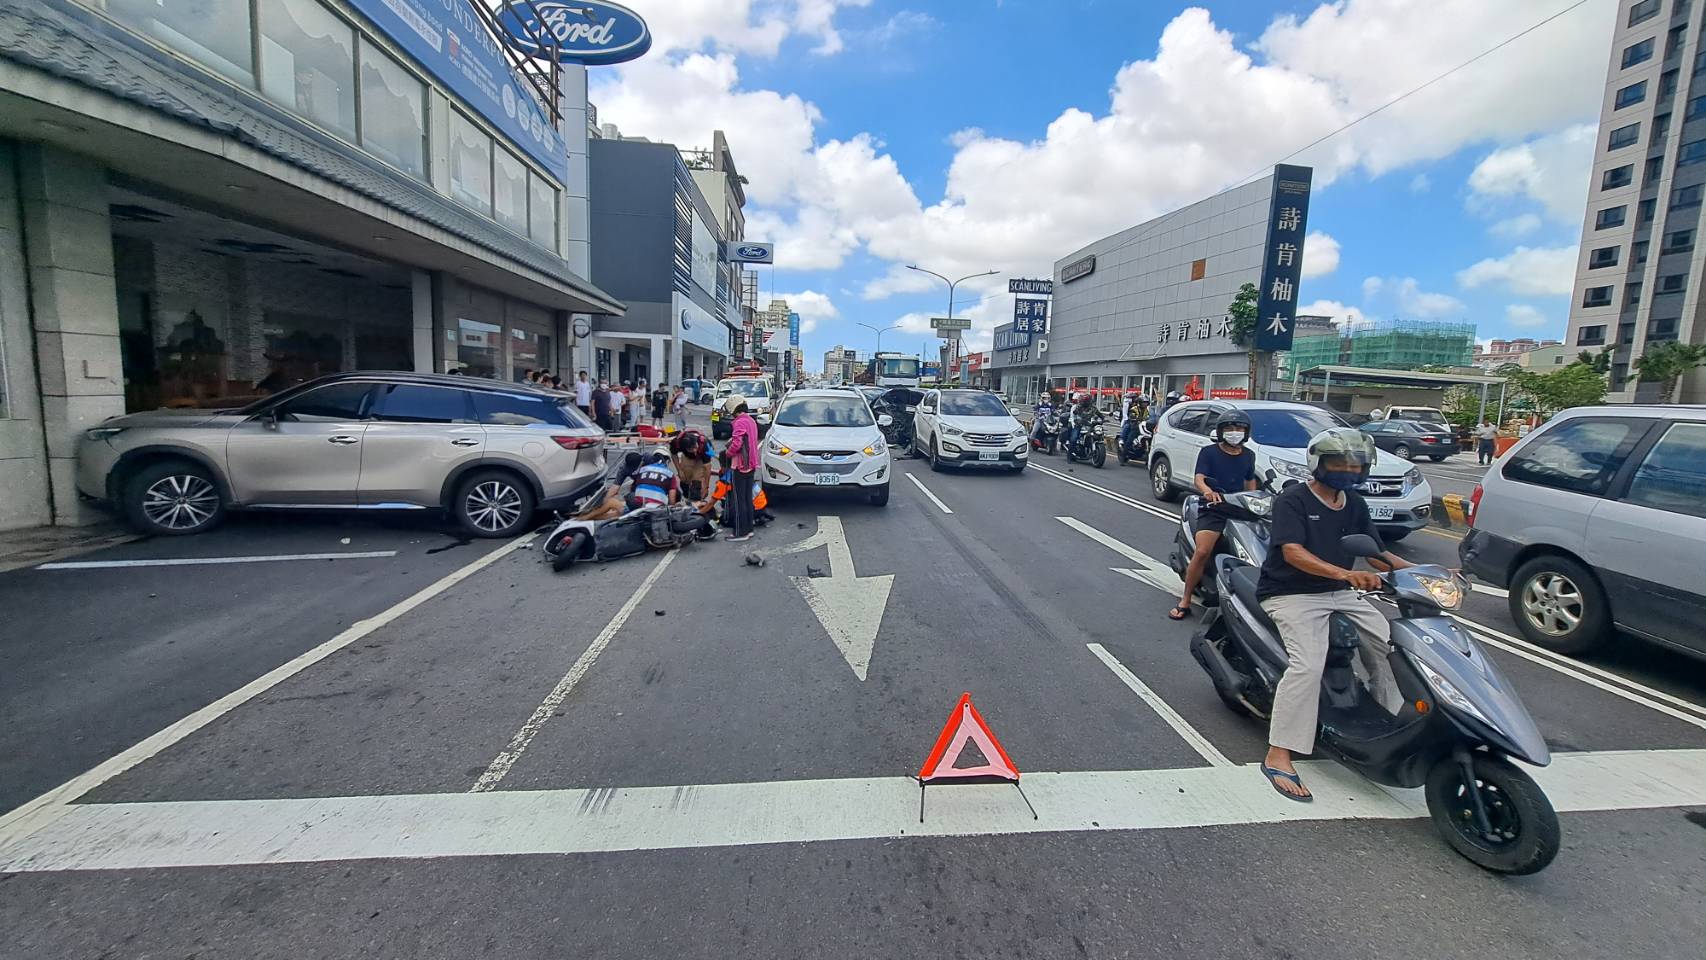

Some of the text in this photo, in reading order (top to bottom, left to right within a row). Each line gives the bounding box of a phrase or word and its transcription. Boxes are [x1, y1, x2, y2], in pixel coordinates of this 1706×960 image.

[523, 4, 616, 45] Ford
[1265, 207, 1301, 336] 詩肯柚木
[1010, 281, 1052, 292] SCANLIVING
[1016, 301, 1046, 316] 詩肯
[1016, 317, 1045, 332] 居家
[1157, 317, 1233, 343] 詩肯柚木
[1037, 339, 1048, 359] P
